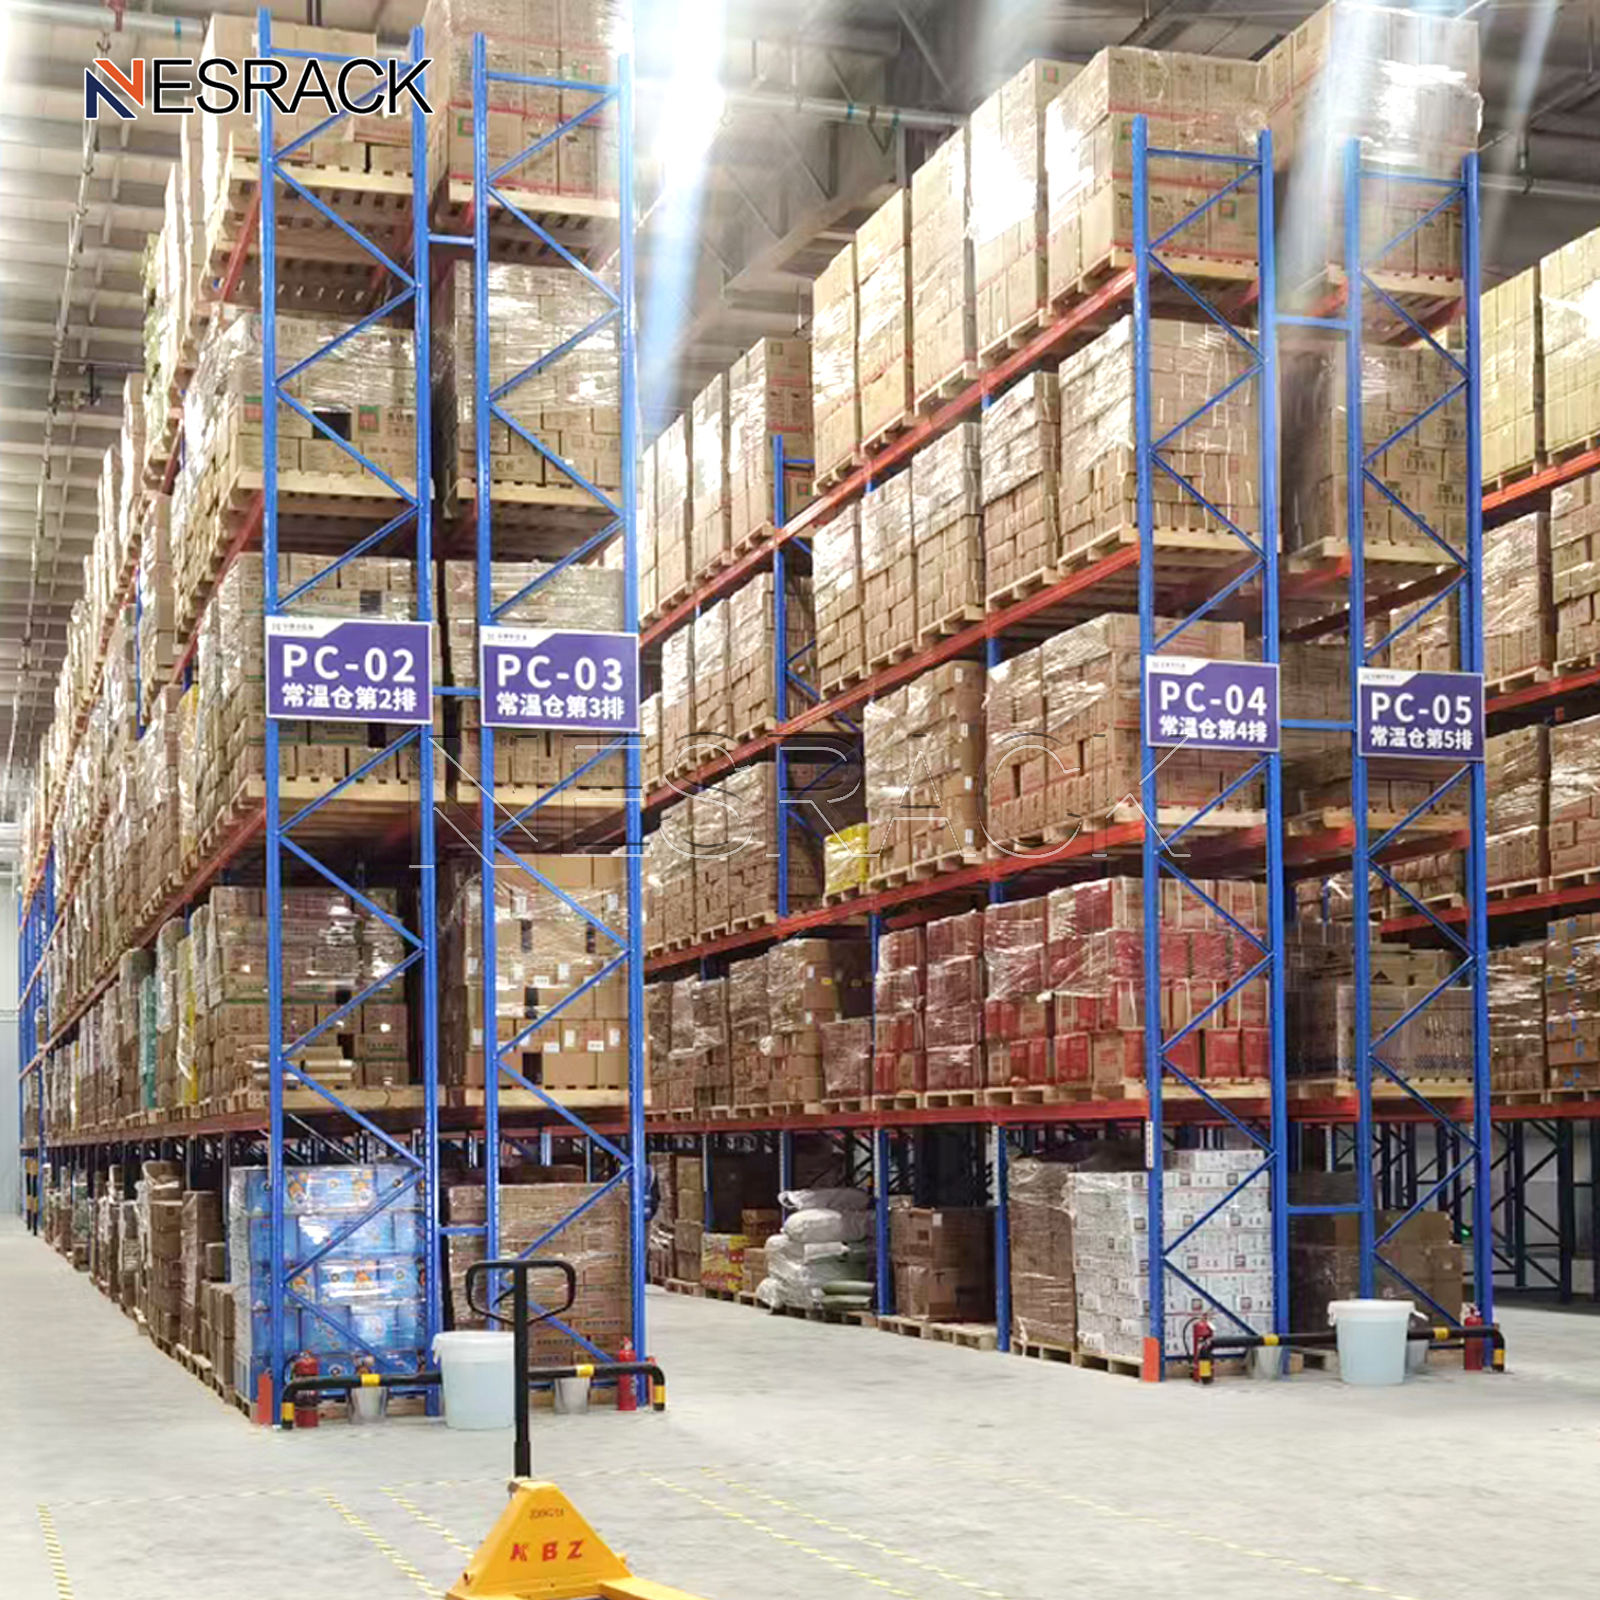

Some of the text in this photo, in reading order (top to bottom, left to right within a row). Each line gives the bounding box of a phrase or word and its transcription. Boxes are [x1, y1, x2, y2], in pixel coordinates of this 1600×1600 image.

[282, 643, 416, 684] PC-02
[498, 653, 623, 692] PC-03
[281, 682, 418, 712] 常温仓第2排
[496, 693, 625, 721] 常温仓第3排
[1159, 680, 1268, 717] PC-04
[1370, 691, 1473, 725] PC-05
[1158, 714, 1268, 743] 常温仓第4排
[1370, 725, 1473, 751] 常温仓第5排
